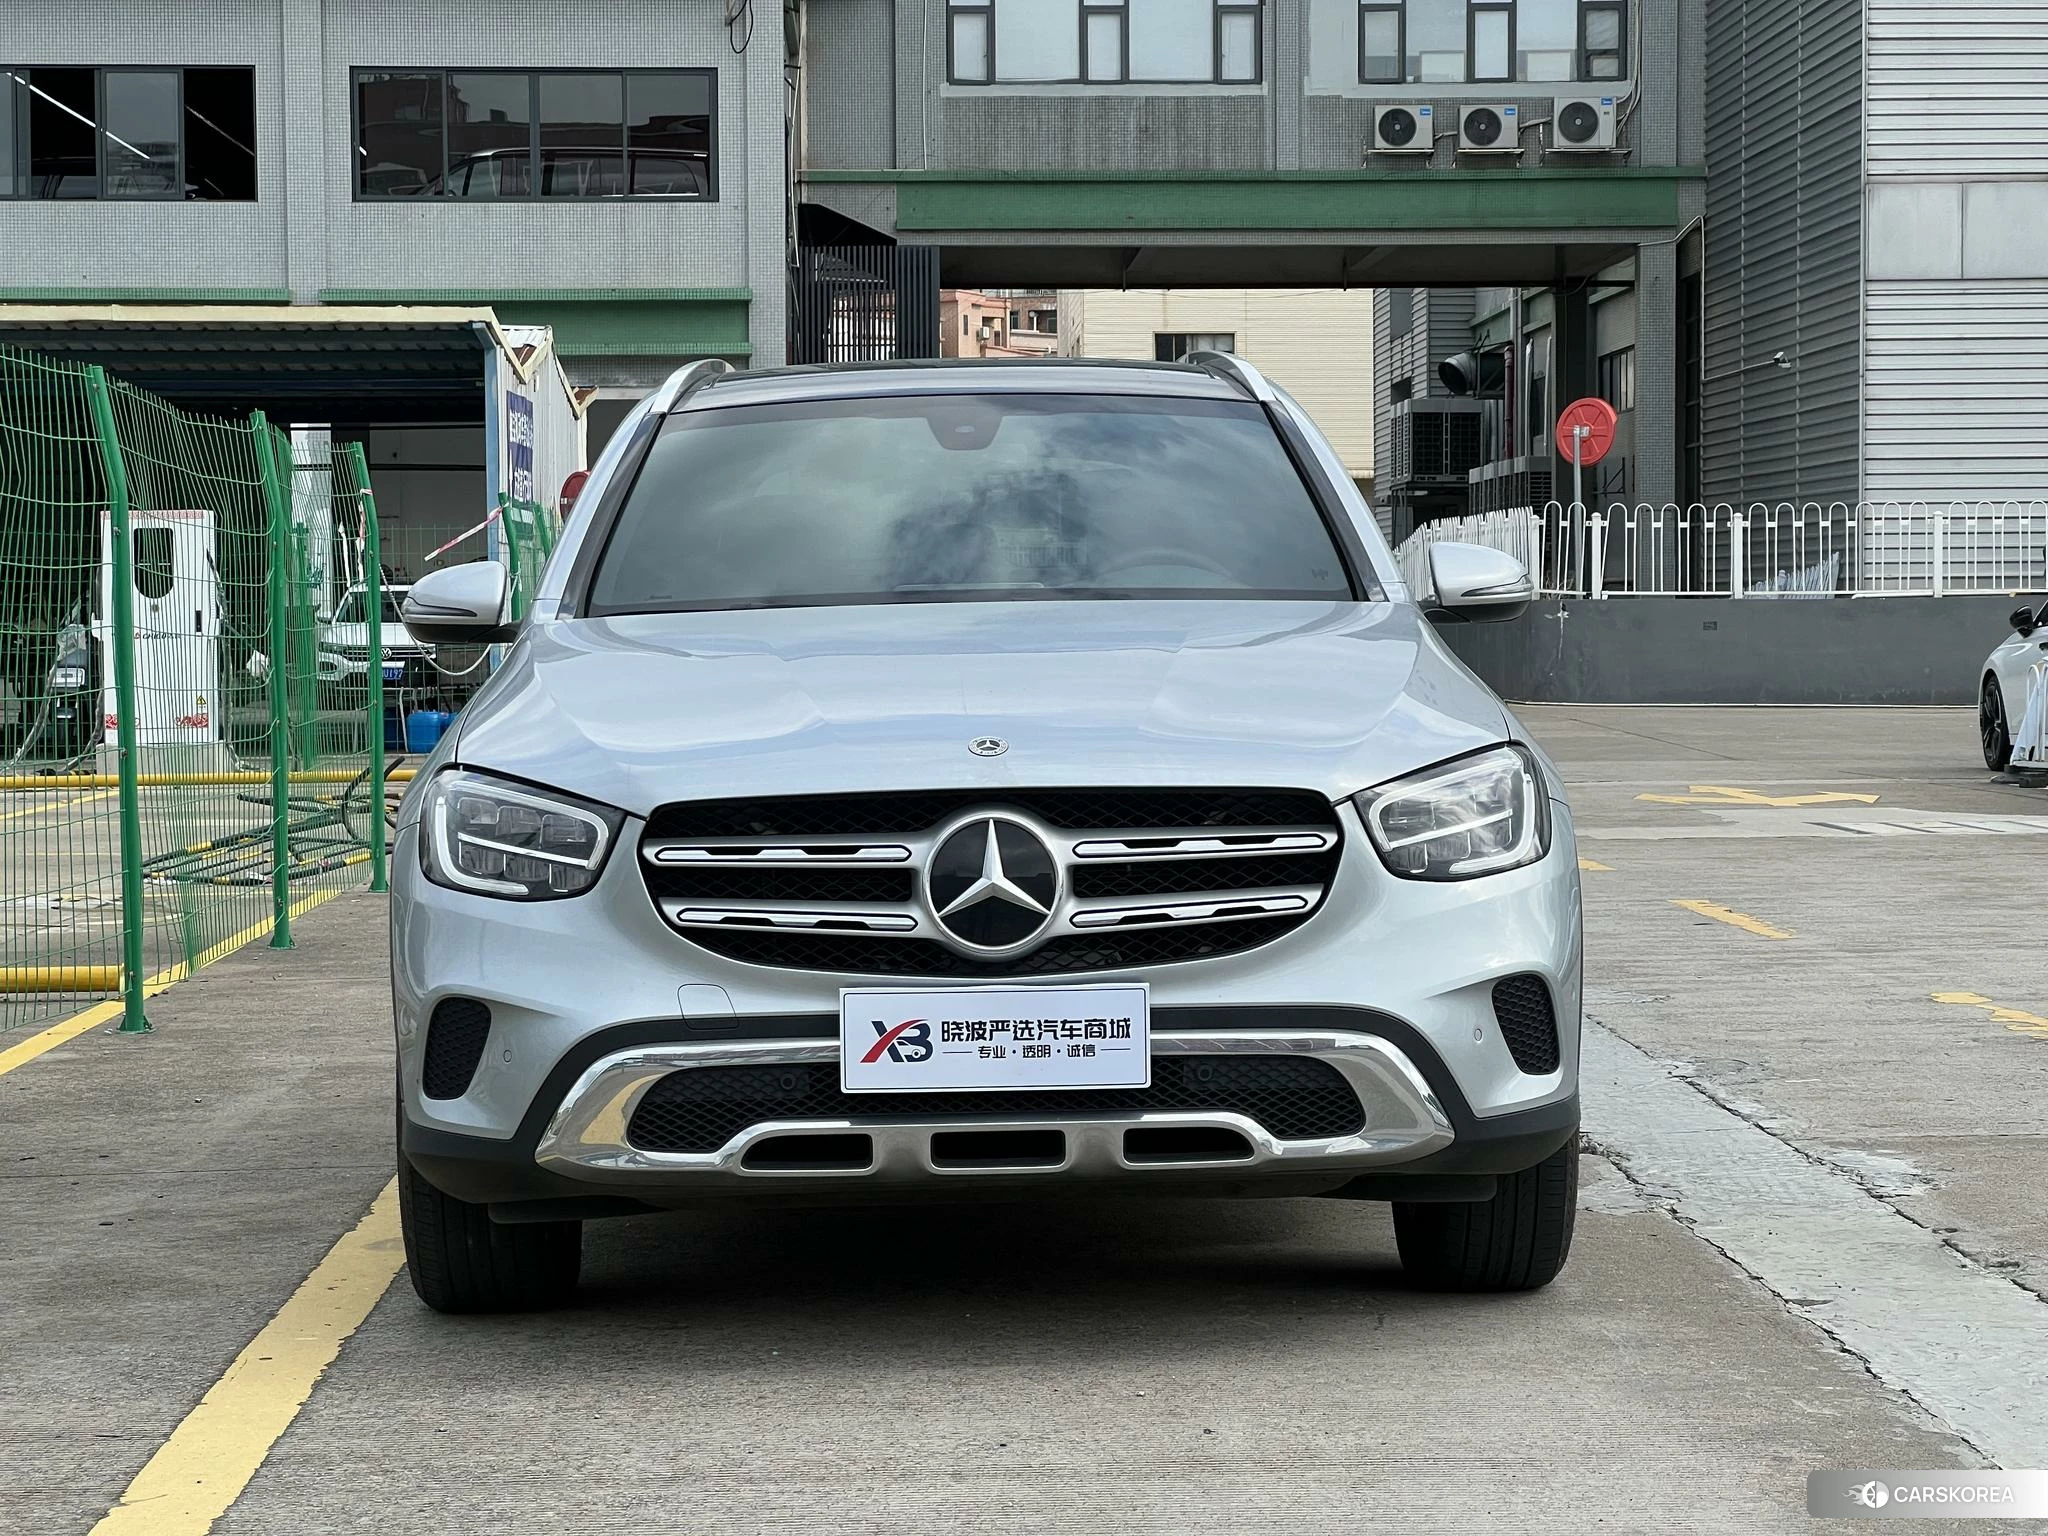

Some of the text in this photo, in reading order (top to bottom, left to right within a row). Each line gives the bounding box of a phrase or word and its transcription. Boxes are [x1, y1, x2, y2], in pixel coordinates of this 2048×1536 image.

[941, 1017, 1131, 1042] 晓波严选汽车商城
